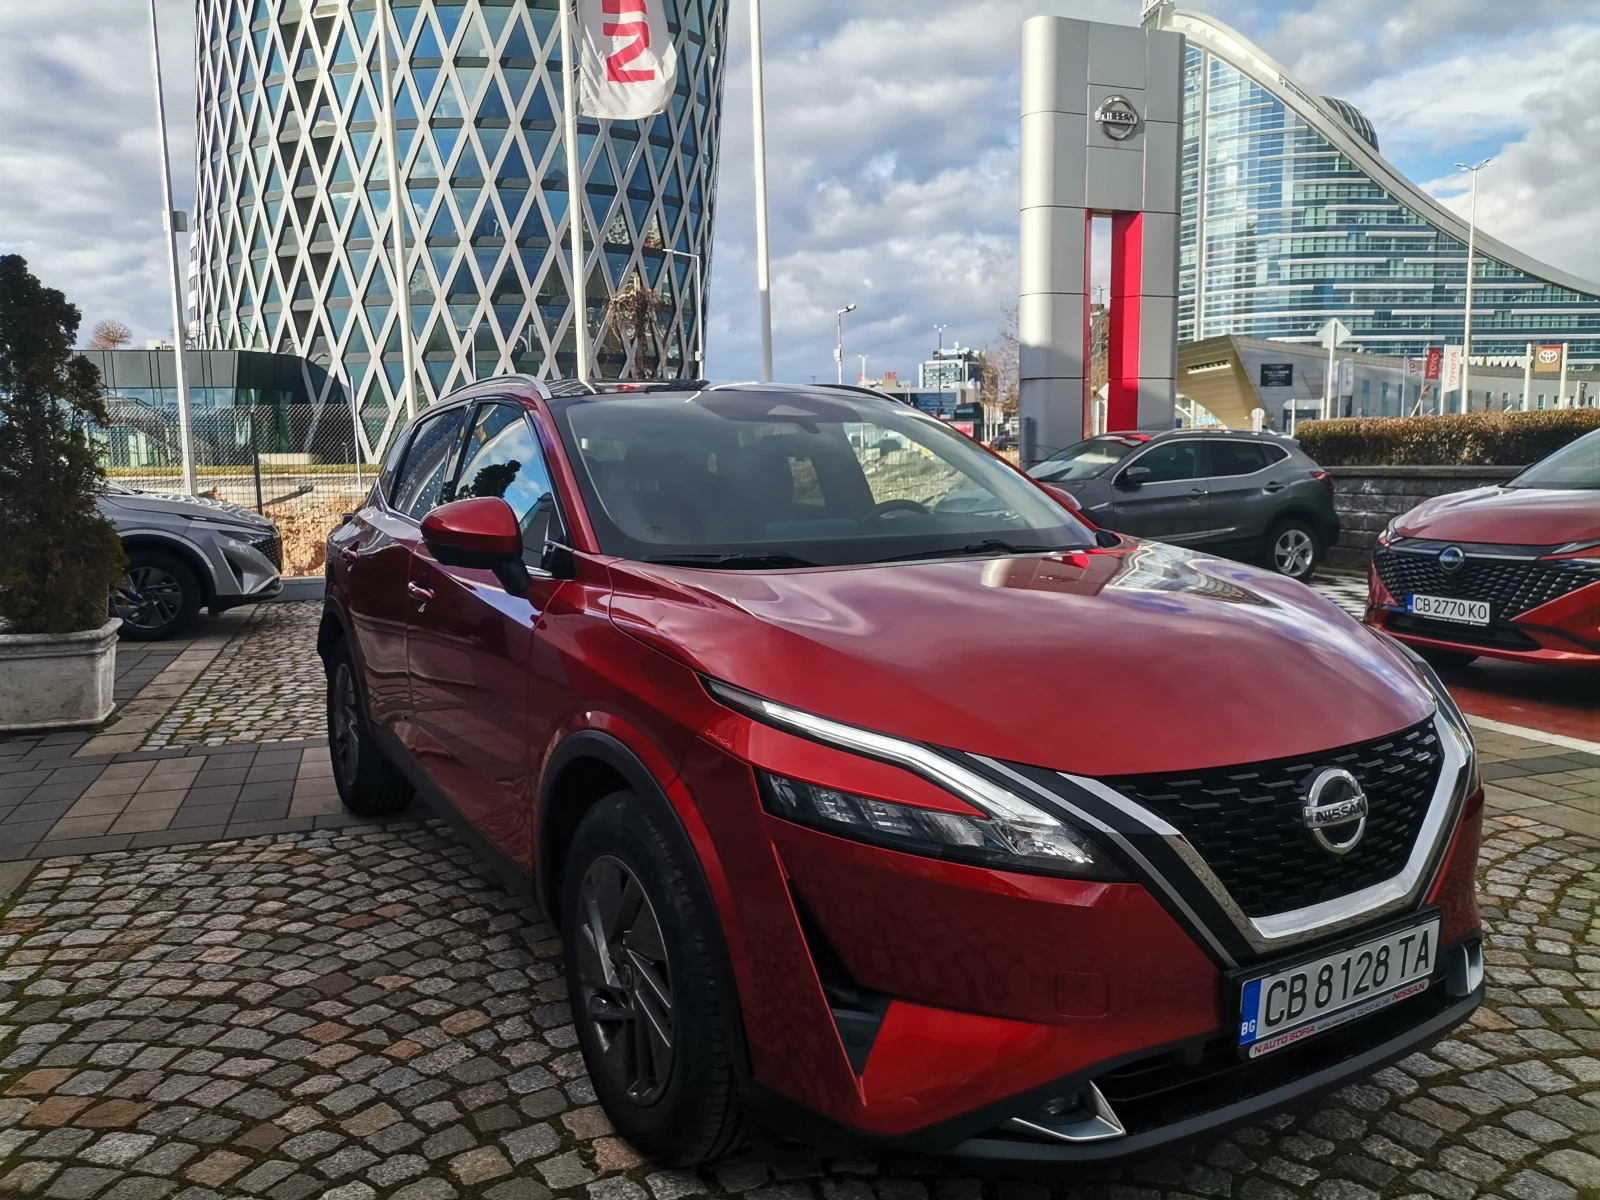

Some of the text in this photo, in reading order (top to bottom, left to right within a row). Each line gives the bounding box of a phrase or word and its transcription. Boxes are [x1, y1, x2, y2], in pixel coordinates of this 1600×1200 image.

[1101, 112, 1135, 122] NISSAN
[1448, 351, 1457, 388] TOYOTA
[1415, 597, 1487, 620] CB 2770 KO
[1315, 802, 1364, 823] NISSAN
[1264, 929, 1430, 1027] CB 8128 TA
[1240, 1019, 1256, 1036] BG
[1253, 1045, 1262, 1054] N
[1262, 1035, 1288, 1051] AUTO
[1289, 1025, 1315, 1041] SOFIA
[1391, 982, 1426, 1001] NISSAN
